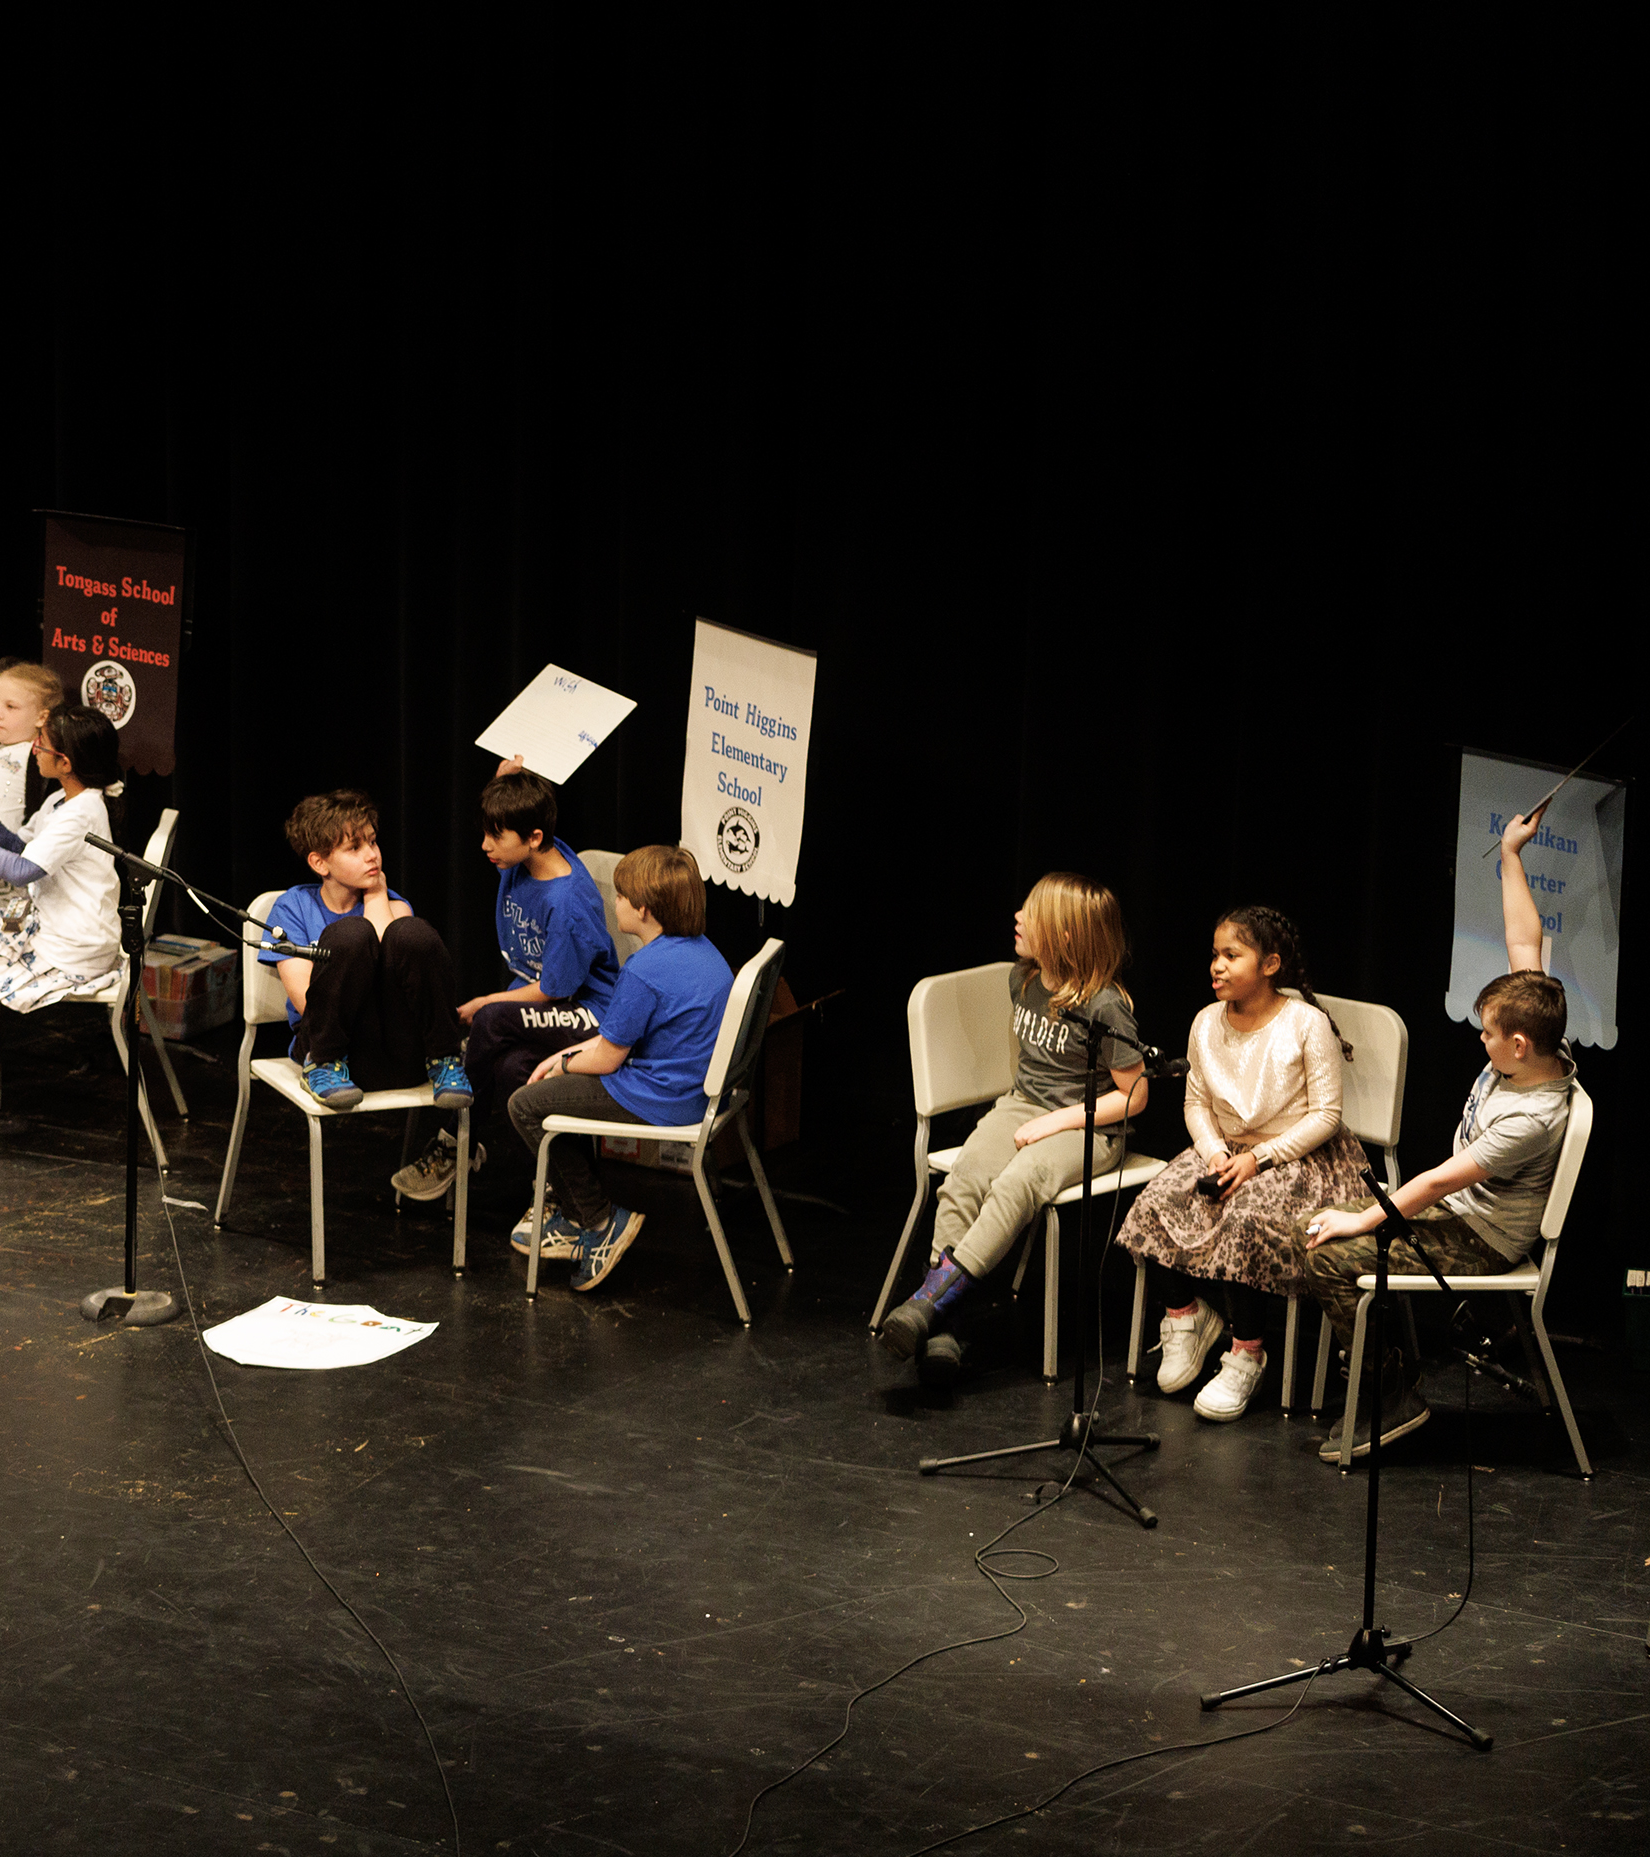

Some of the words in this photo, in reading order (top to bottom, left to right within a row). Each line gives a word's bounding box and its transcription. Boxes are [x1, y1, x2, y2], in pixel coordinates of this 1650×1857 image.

[56, 565, 117, 597] Tongass
[121, 577, 176, 605] School
[101, 607, 118, 627] of
[51, 627, 87, 652] Arts
[92, 635, 104, 655] &
[108, 637, 170, 667] Sciences
[704, 685, 739, 720] Point
[745, 702, 798, 741] Higgins
[711, 731, 788, 783] Elementary
[717, 771, 762, 807] School
[520, 1007, 580, 1029] Hurley
